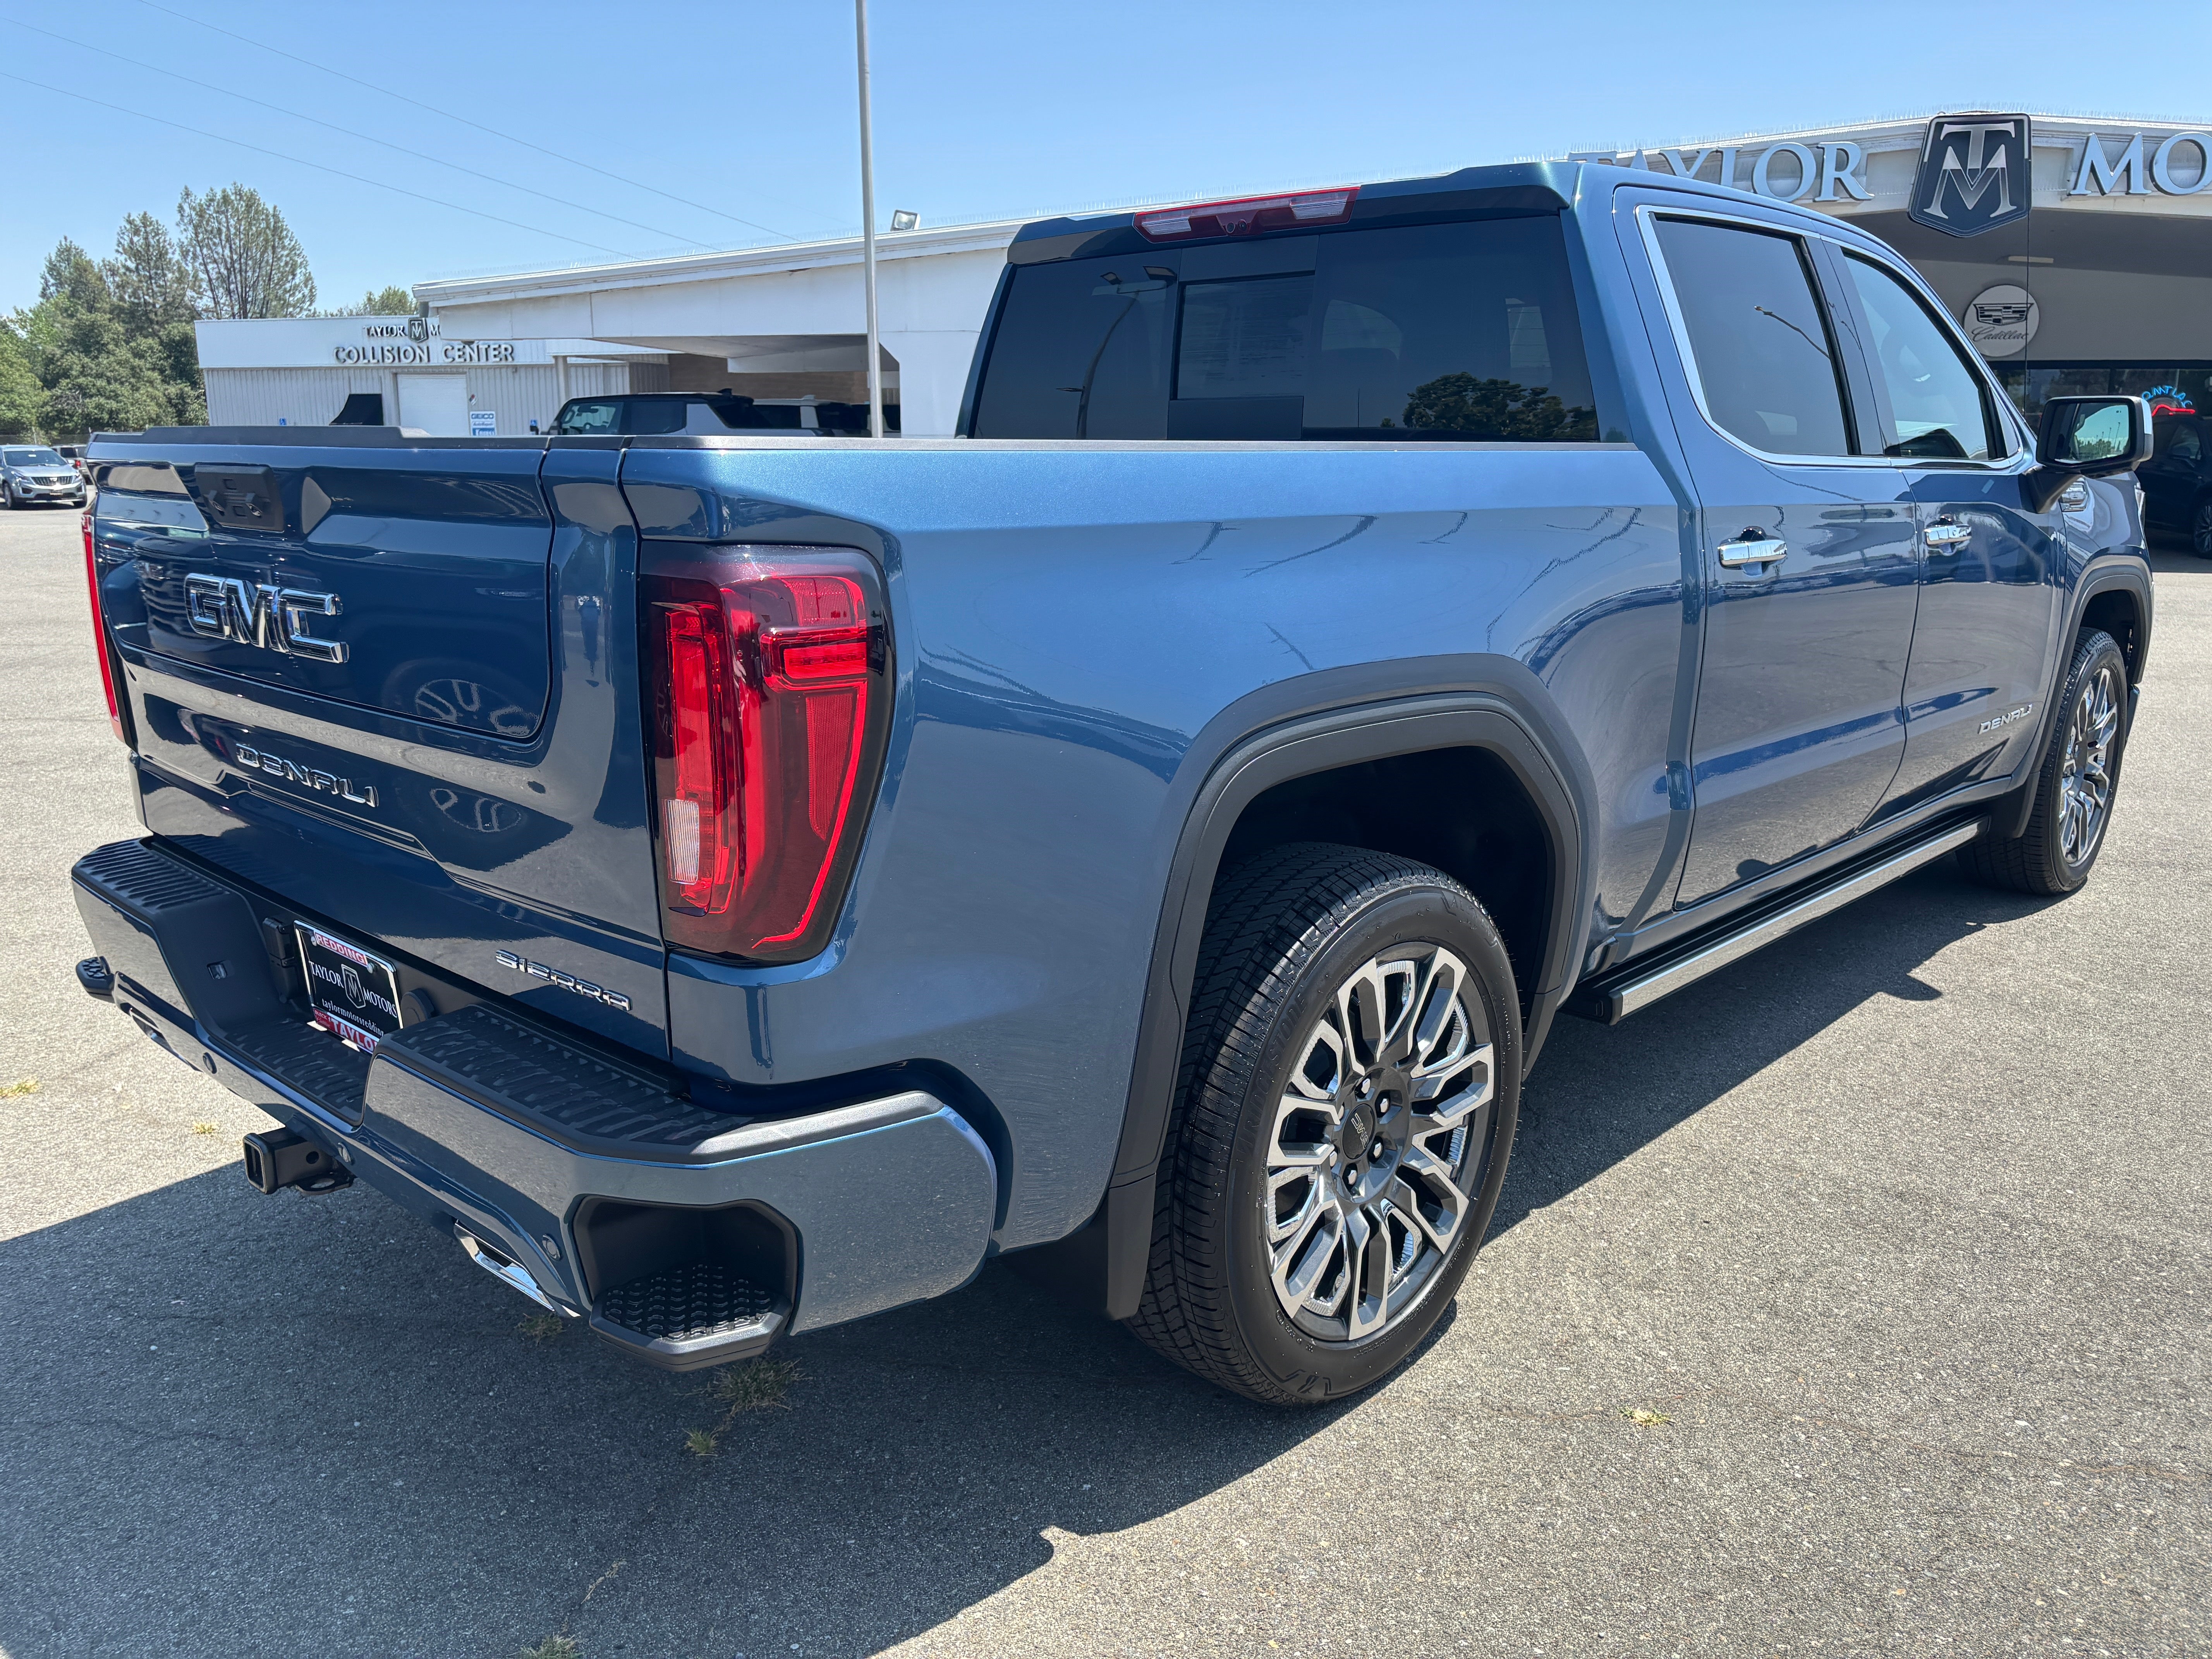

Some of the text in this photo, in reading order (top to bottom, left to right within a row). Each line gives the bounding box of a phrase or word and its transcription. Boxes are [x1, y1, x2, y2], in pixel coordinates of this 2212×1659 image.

[363, 325, 407, 337] TAYLOR
[430, 324, 440, 336] M
[1972, 326, 2029, 342] Cadillac
[333, 343, 514, 364] COLLISION CENTER
[184, 573, 350, 663] GMC
[1978, 704, 2032, 735] DENALI
[235, 743, 380, 808] DENALI
[316, 934, 365, 963] REDDING
[309, 961, 344, 988] TAYLOR
[362, 986, 398, 1018] MOTORS
[495, 949, 632, 1011] SIERRA
[332, 1019, 378, 1051] TAYLO
[1351, 1112, 1370, 1149] GMC
